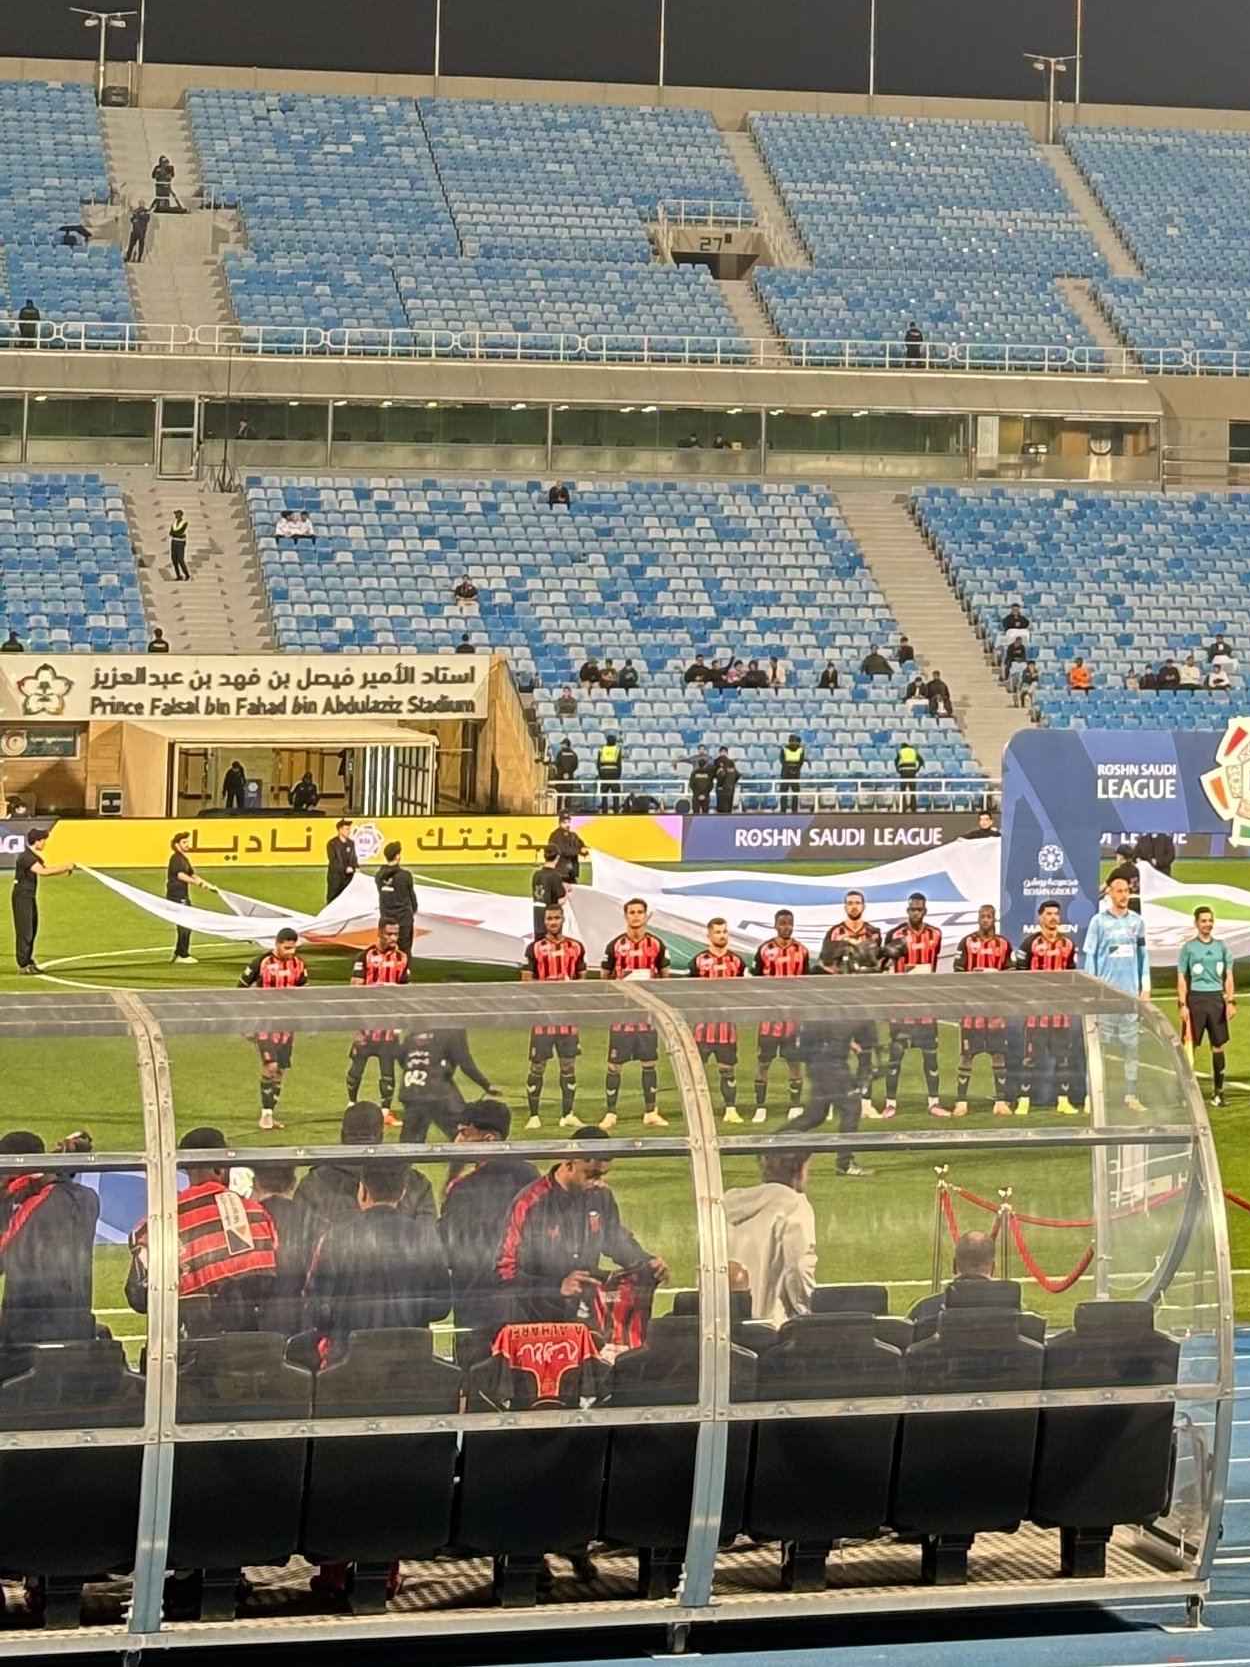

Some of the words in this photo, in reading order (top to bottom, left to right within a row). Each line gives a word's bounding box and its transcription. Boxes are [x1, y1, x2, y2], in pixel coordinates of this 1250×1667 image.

[700, 237, 722, 251] 27
[189, 670, 211, 691] بن
[218, 667, 261, 691] فهد
[268, 670, 290, 690] بن
[297, 667, 354, 691] فيصل
[359, 663, 415, 689] الأمير
[421, 665, 475, 684] استاد
[90, 696, 145, 715] Prince
[150, 696, 200, 716] Faisal
[204, 696, 231, 715] bin
[236, 695, 287, 715] Fahad
[291, 695, 317, 715] bin
[322, 695, 403, 715] Abdulaziz
[407, 694, 475, 714] Stadium
[1098, 764, 1138, 776] ROSHN
[1141, 764, 1176, 776] SAUDI
[1097, 779, 1176, 799] LEAGUE
[735, 829, 801, 847] ROSHN
[809, 829, 865, 846] SAUDI
[874, 828, 943, 845] LEAGUE
